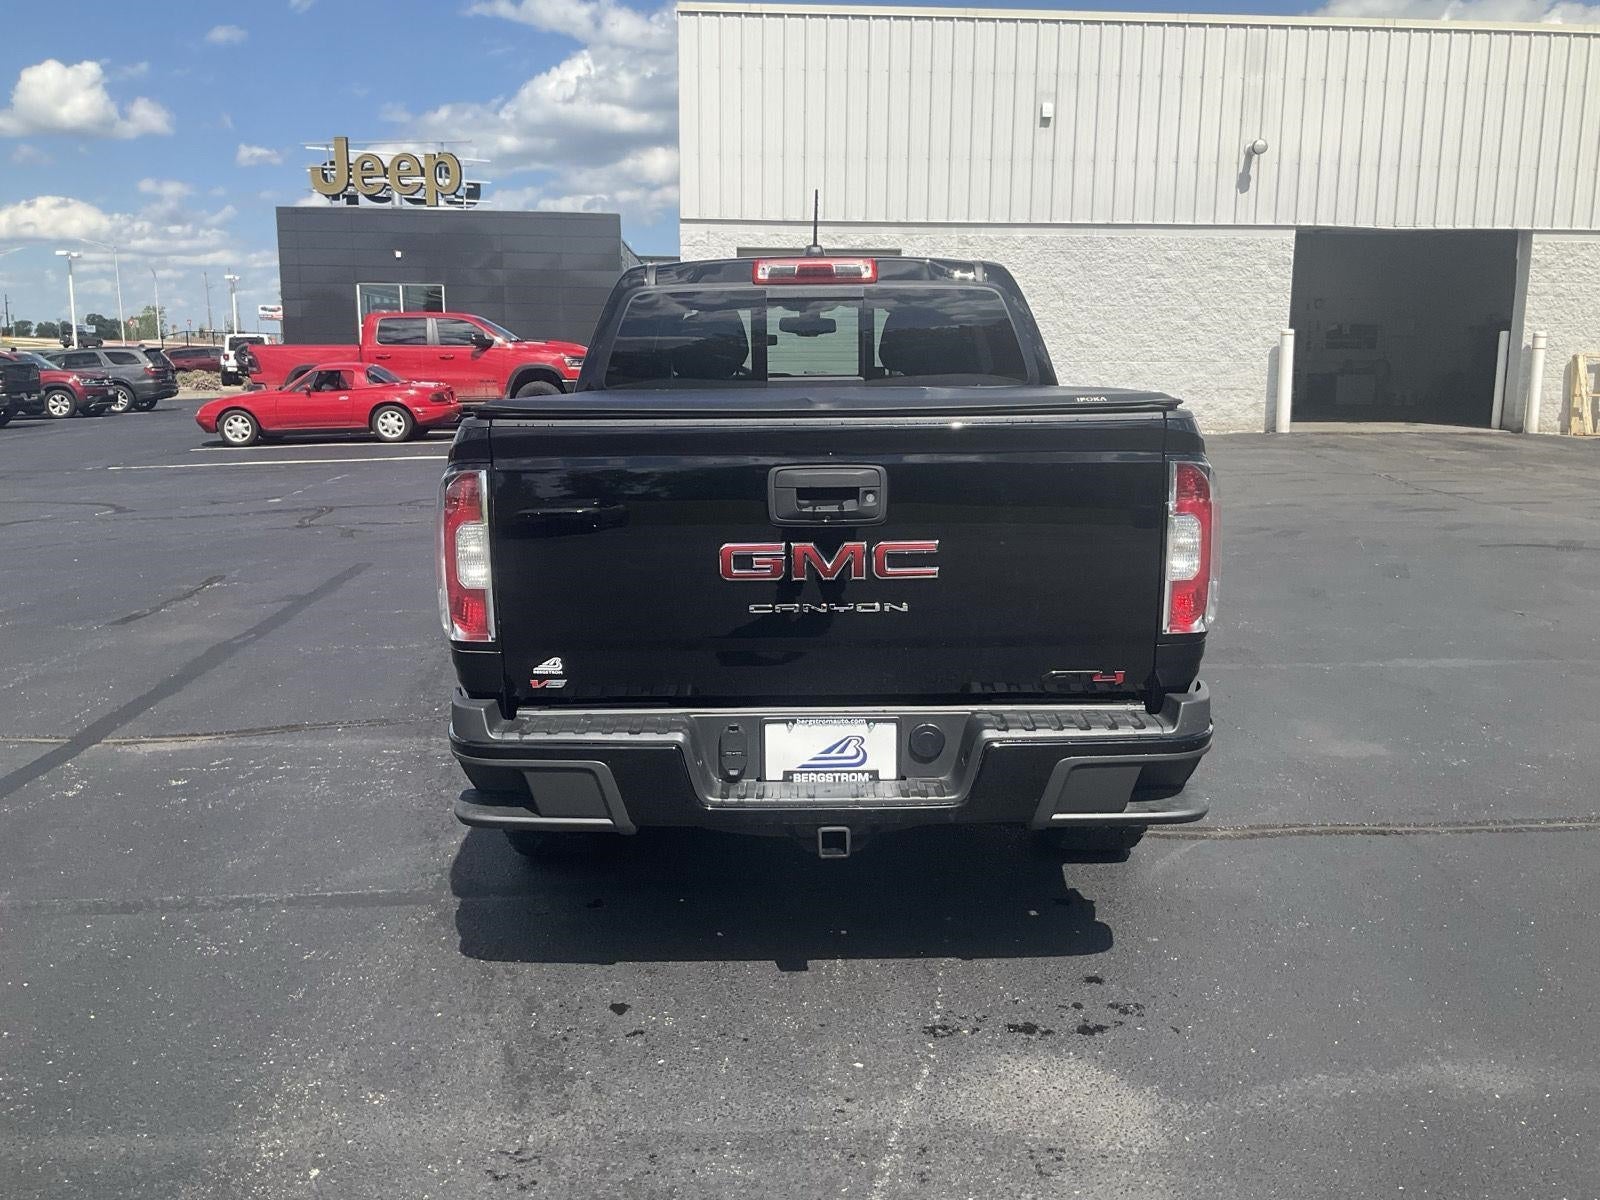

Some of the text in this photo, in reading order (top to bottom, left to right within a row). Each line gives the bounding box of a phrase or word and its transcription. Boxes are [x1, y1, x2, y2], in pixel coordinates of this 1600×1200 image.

[310, 136, 462, 207] Jeep
[719, 540, 939, 580] GMC
[749, 602, 909, 613] CANYON
[796, 718, 866, 727] bergstromauto.com
[792, 772, 870, 783] BERGSTROM
